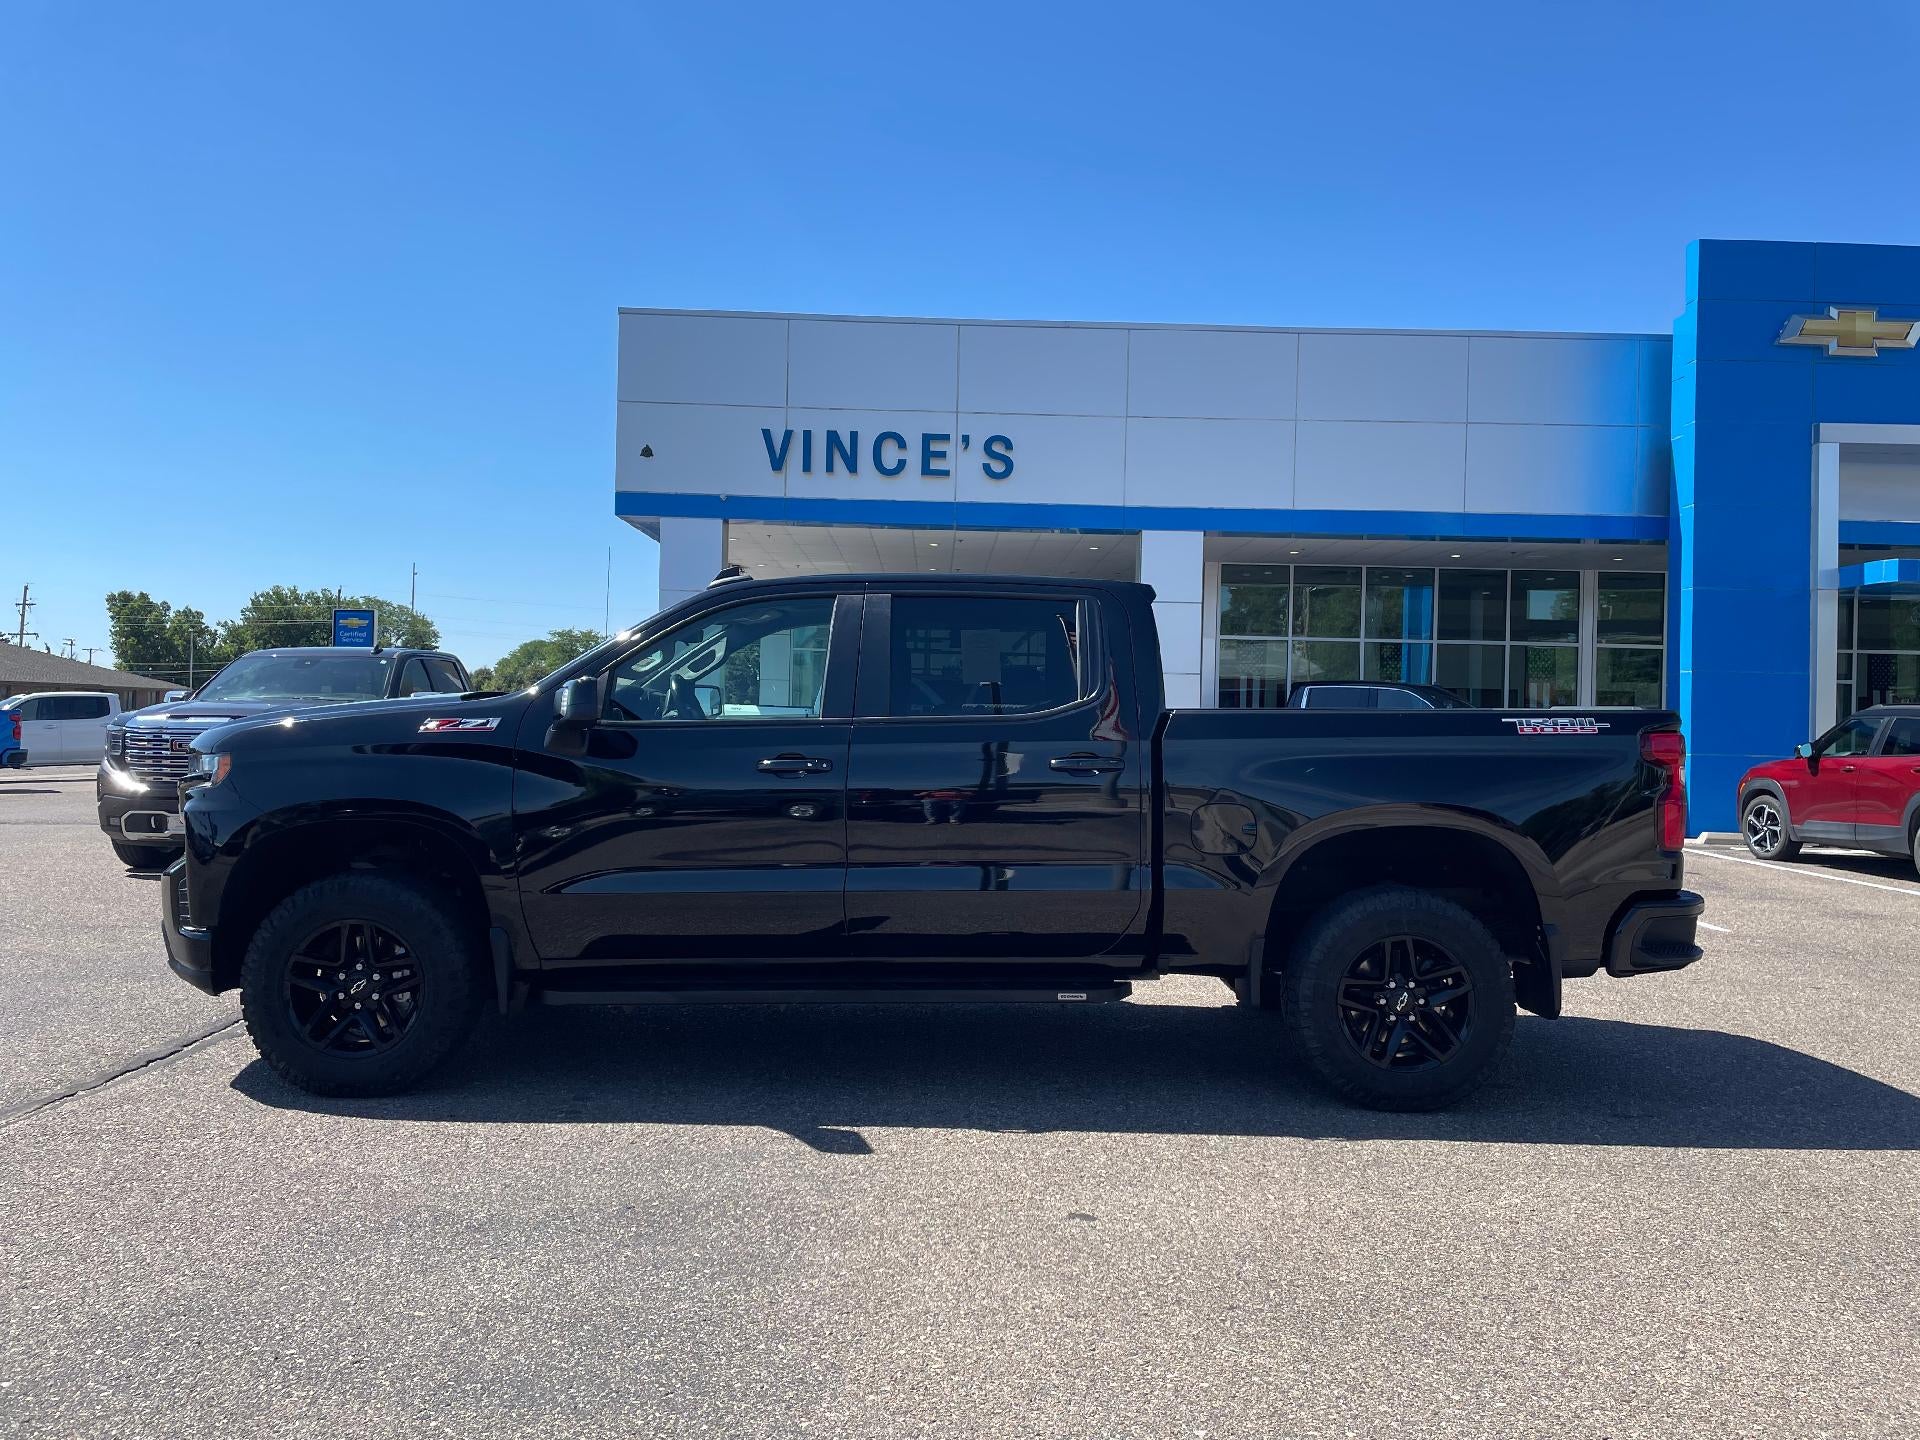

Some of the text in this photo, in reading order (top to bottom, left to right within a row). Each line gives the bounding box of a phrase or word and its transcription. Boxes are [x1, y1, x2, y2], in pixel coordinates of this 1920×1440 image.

[761, 428, 1014, 480] VINCE'S
[339, 630, 367, 638] Certified
[418, 717, 502, 733] Z71
[1501, 718, 1611, 728] TRAIL
[1518, 726, 1599, 735] BOSS
